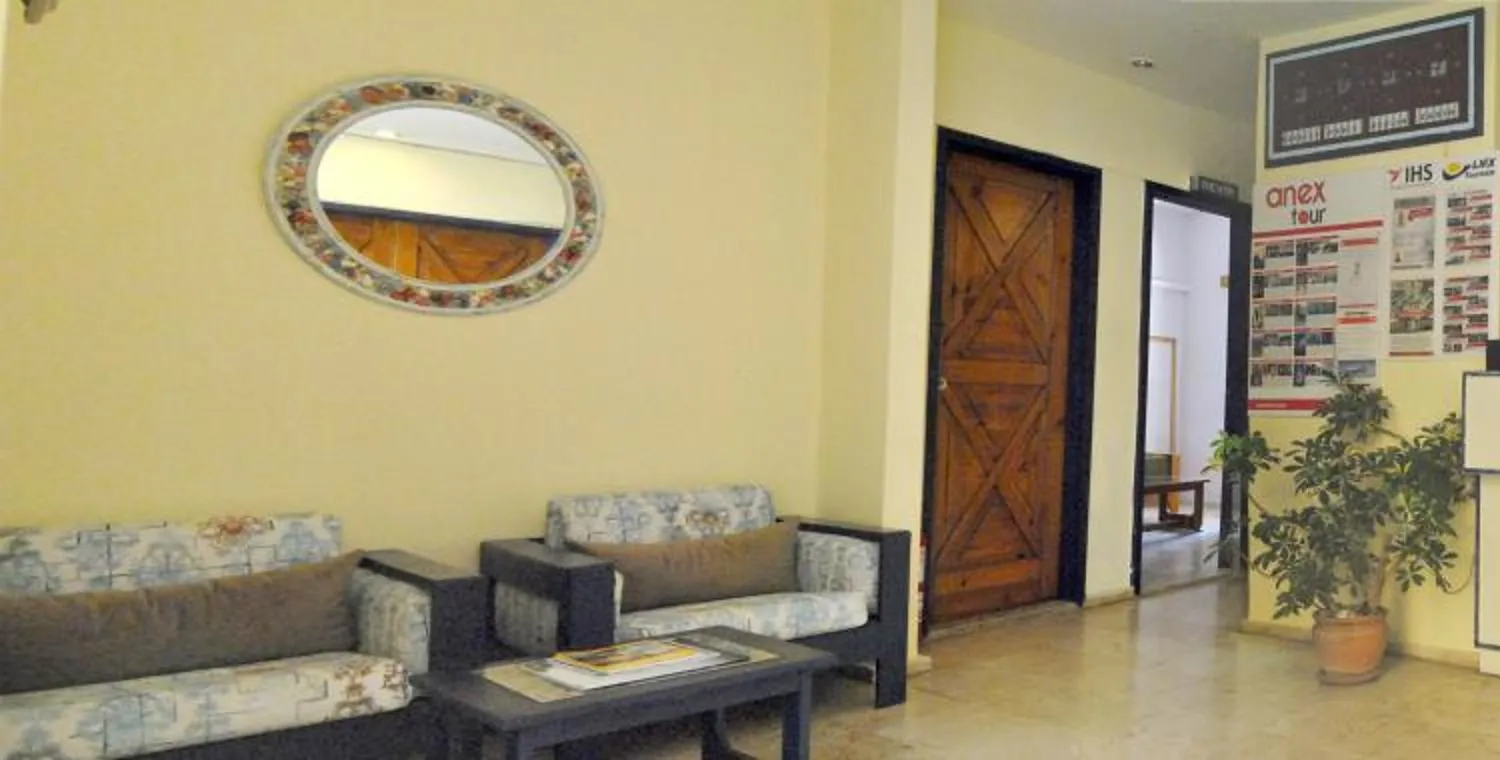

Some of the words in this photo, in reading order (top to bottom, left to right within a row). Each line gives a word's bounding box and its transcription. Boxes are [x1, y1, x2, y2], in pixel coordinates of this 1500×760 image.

[1405, 164, 1433, 183] IHS
[1265, 181, 1326, 208] anex
[1291, 207, 1327, 225] tour
